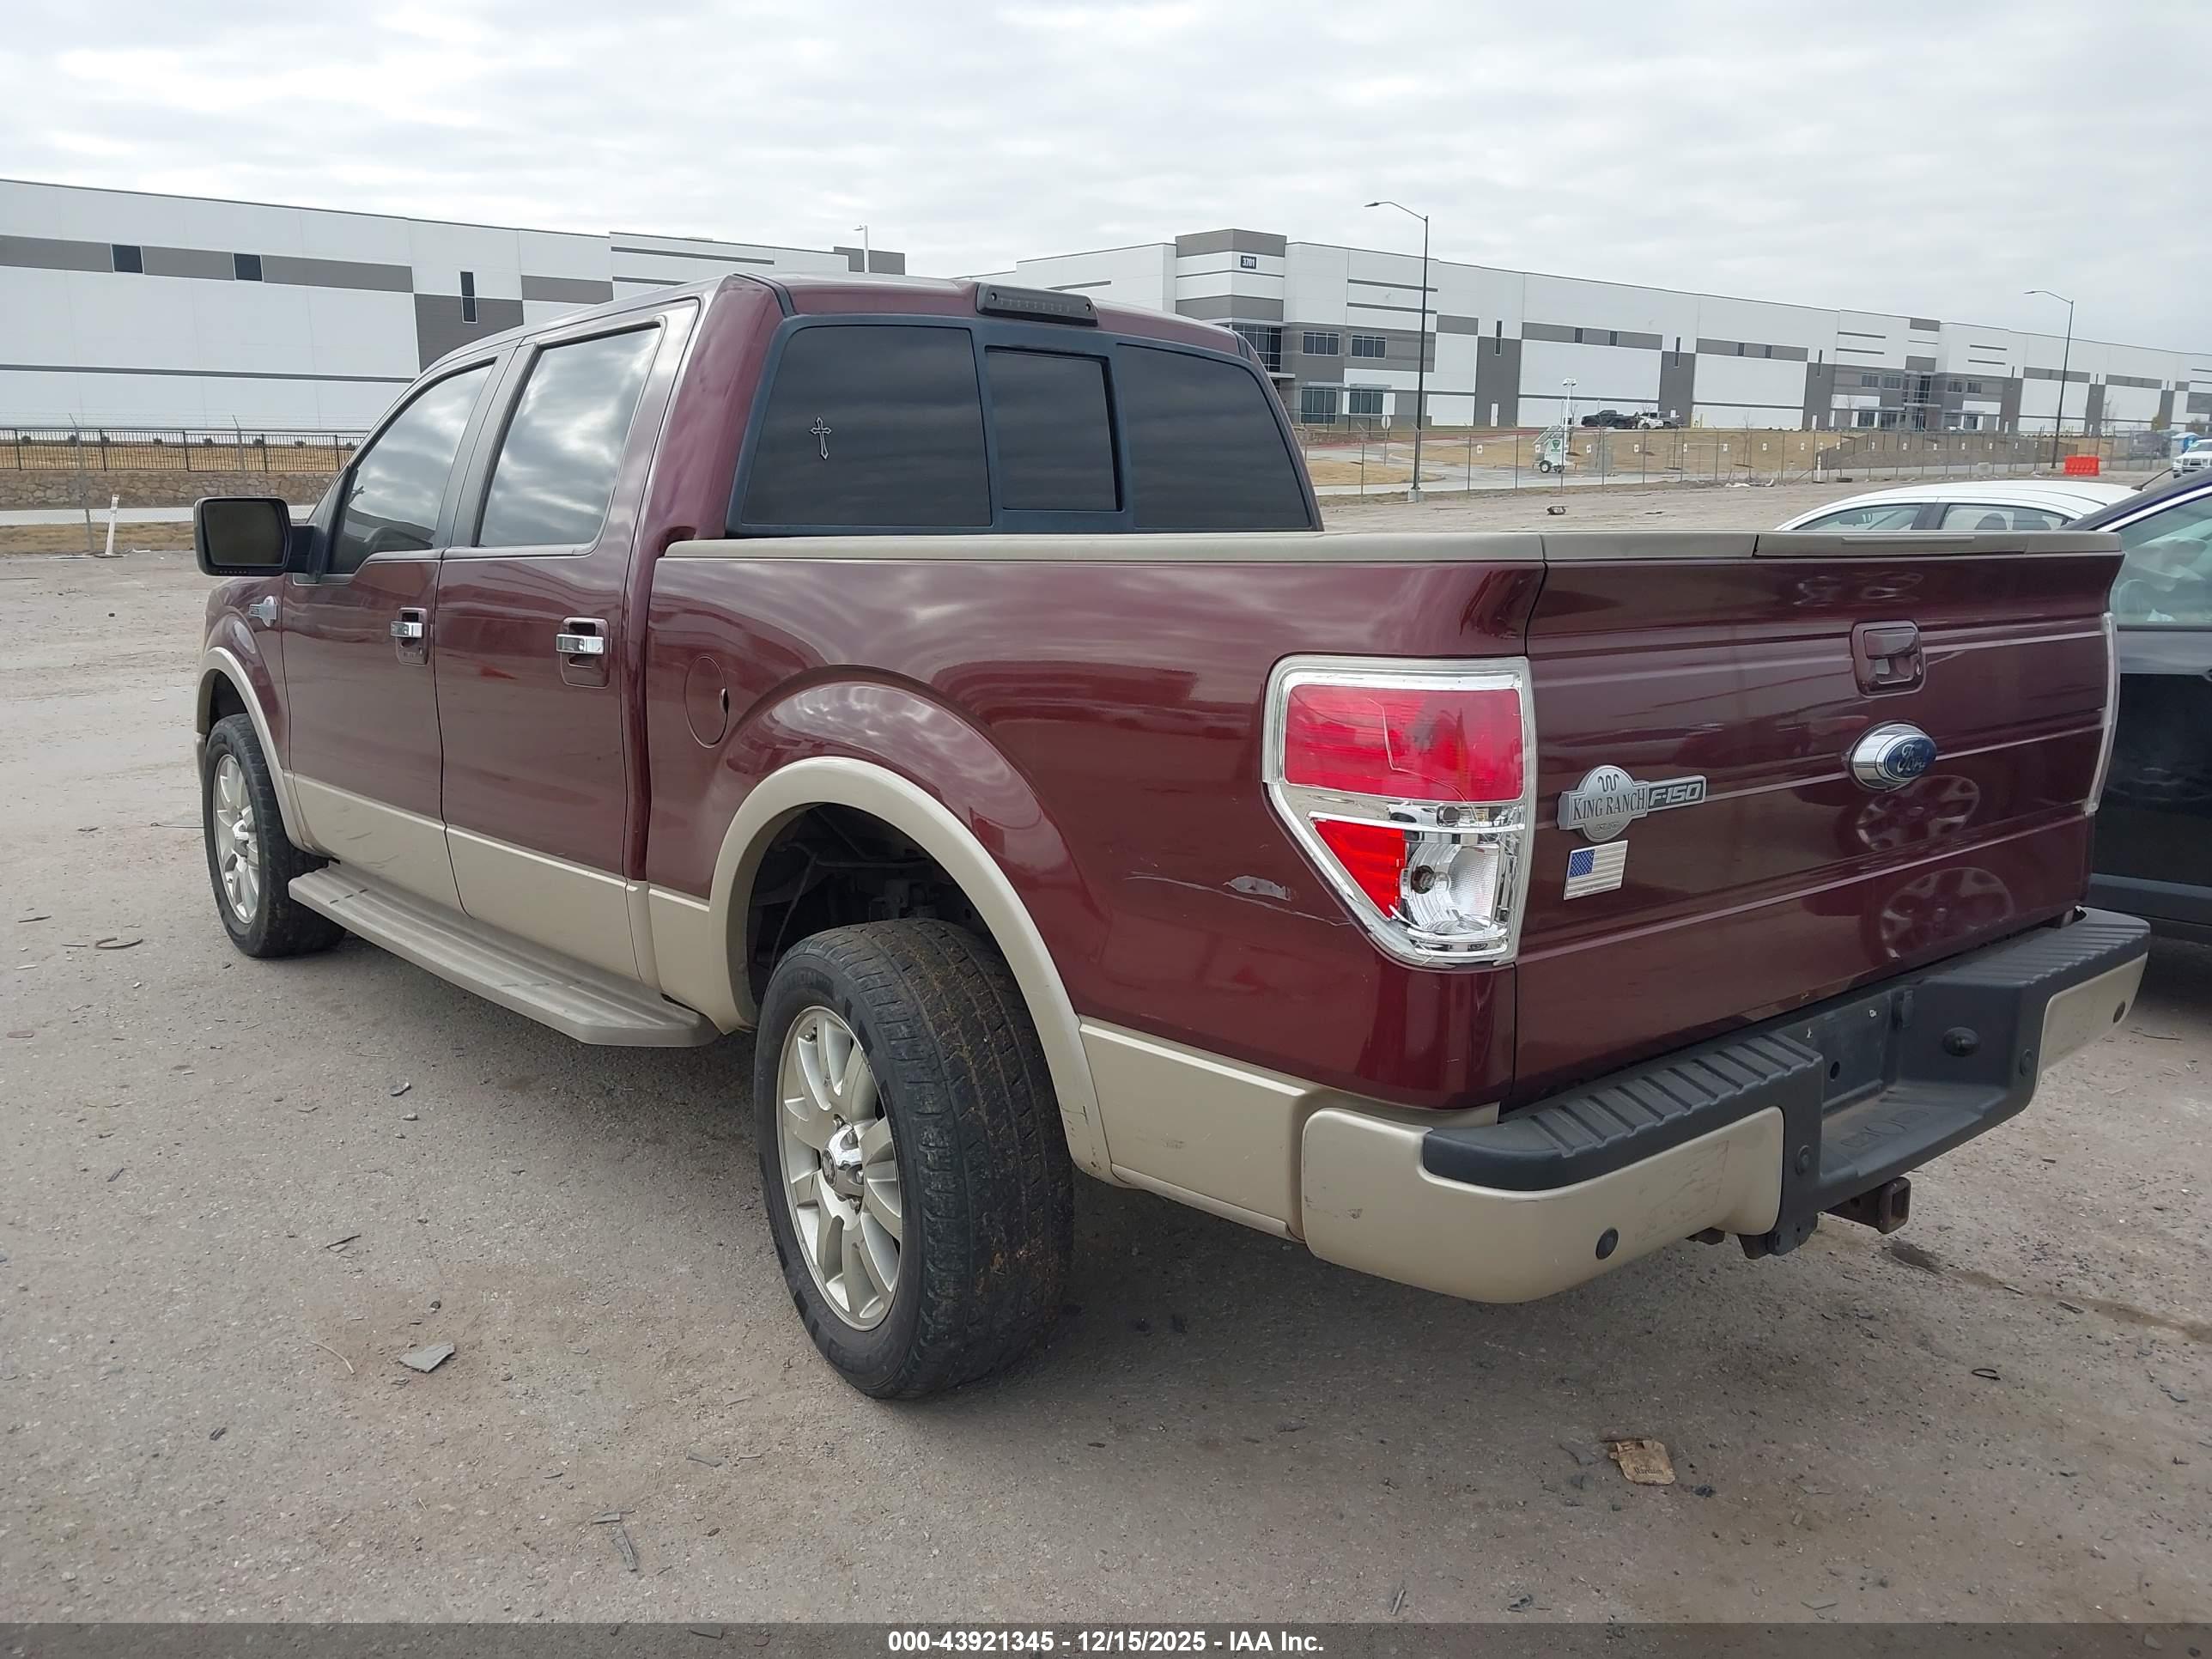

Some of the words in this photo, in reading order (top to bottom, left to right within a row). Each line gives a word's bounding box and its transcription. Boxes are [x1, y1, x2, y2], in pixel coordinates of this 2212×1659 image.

[1242, 257, 1255, 268] 3701
[1572, 798, 1603, 821] KING
[1606, 787, 1647, 815] RANCH
[1649, 782, 1702, 806] F-150
